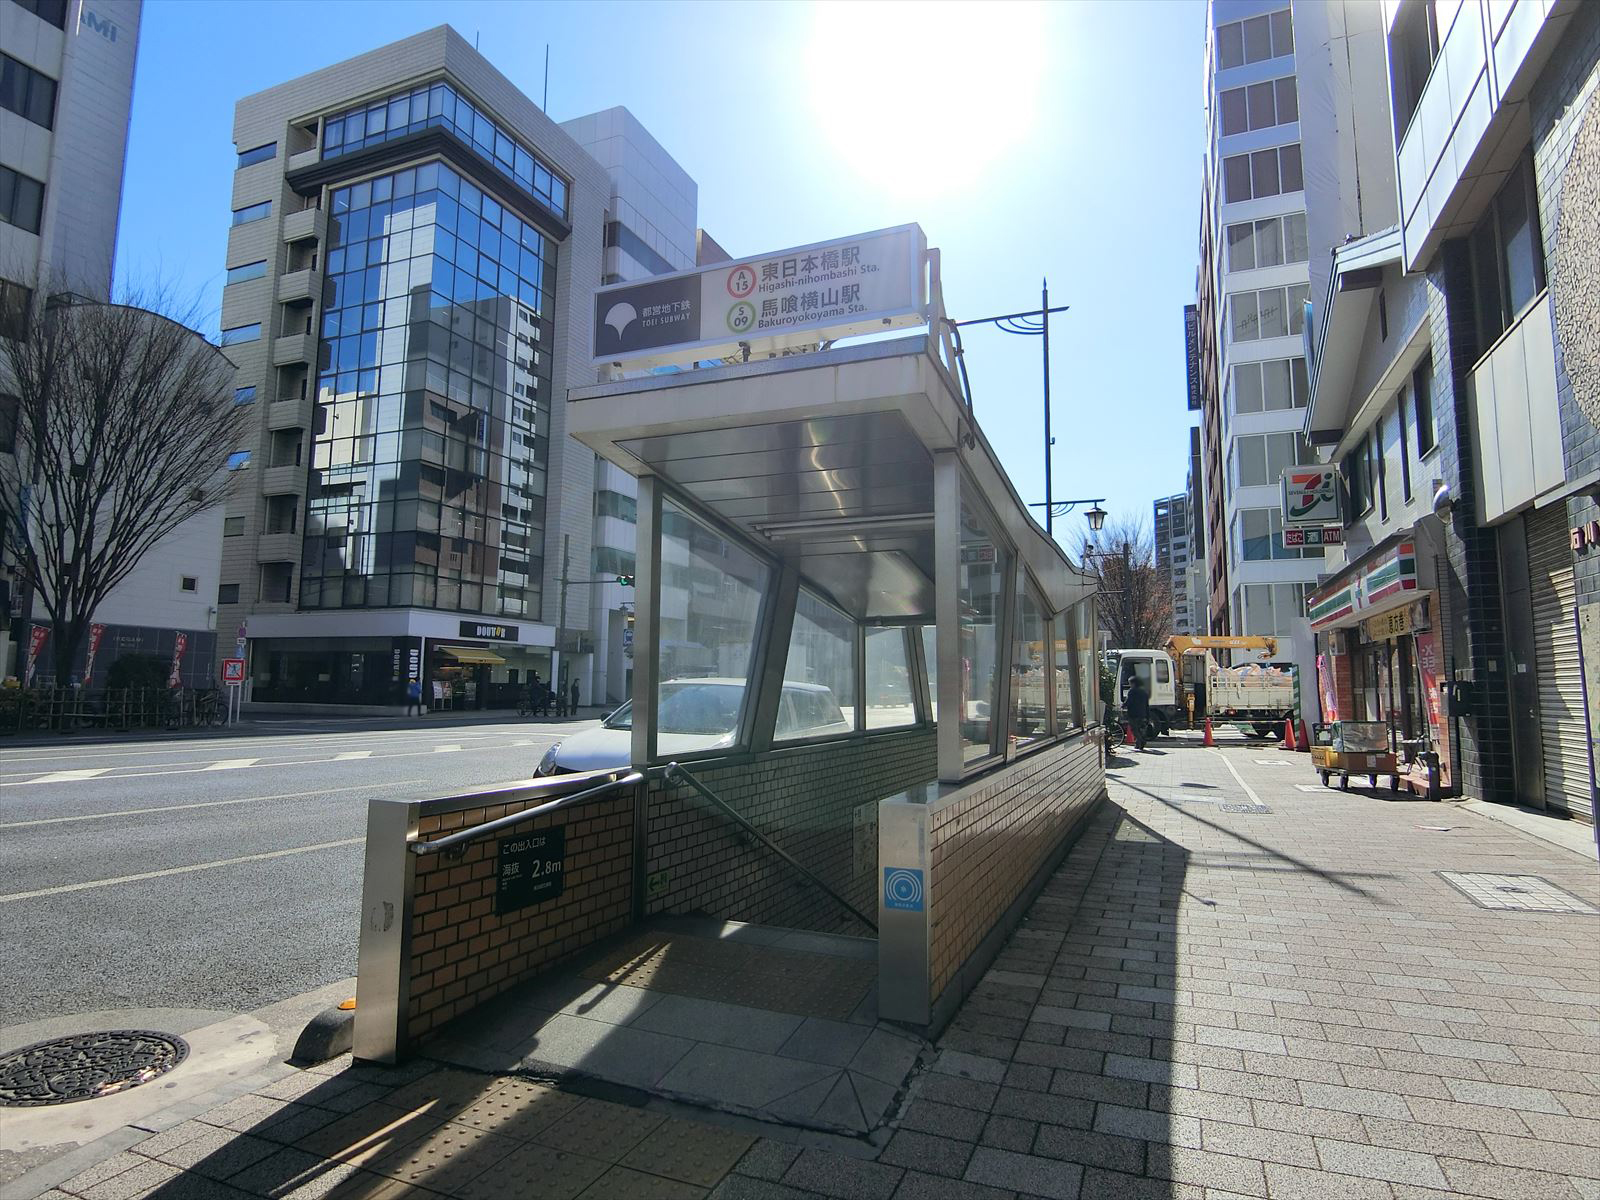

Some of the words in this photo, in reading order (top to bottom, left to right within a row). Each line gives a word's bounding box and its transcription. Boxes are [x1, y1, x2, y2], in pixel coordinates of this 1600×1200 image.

[761, 245, 861, 282] 東日本橋駅
[738, 271, 746, 281] A
[758, 268, 857, 294] Higashi-nihombashi
[860, 264, 880, 277] Sta.
[735, 280, 749, 292] 15
[642, 299, 691, 318] 都営地下鉄
[761, 283, 861, 318] 馬喰横山駅
[738, 306, 745, 316] S
[758, 306, 845, 330] Bakuroyokoyama
[848, 302, 868, 314] Sta.
[642, 317, 658, 328] TOEI
[660, 312, 691, 325] SUBWAY
[734, 316, 748, 328] 09
[1323, 530, 1340, 542] ATM
[476, 625, 506, 638] DOUTOR
[503, 837, 545, 855] この出入口は
[503, 862, 519, 876] 海抜
[532, 859, 561, 879] 2.8m
